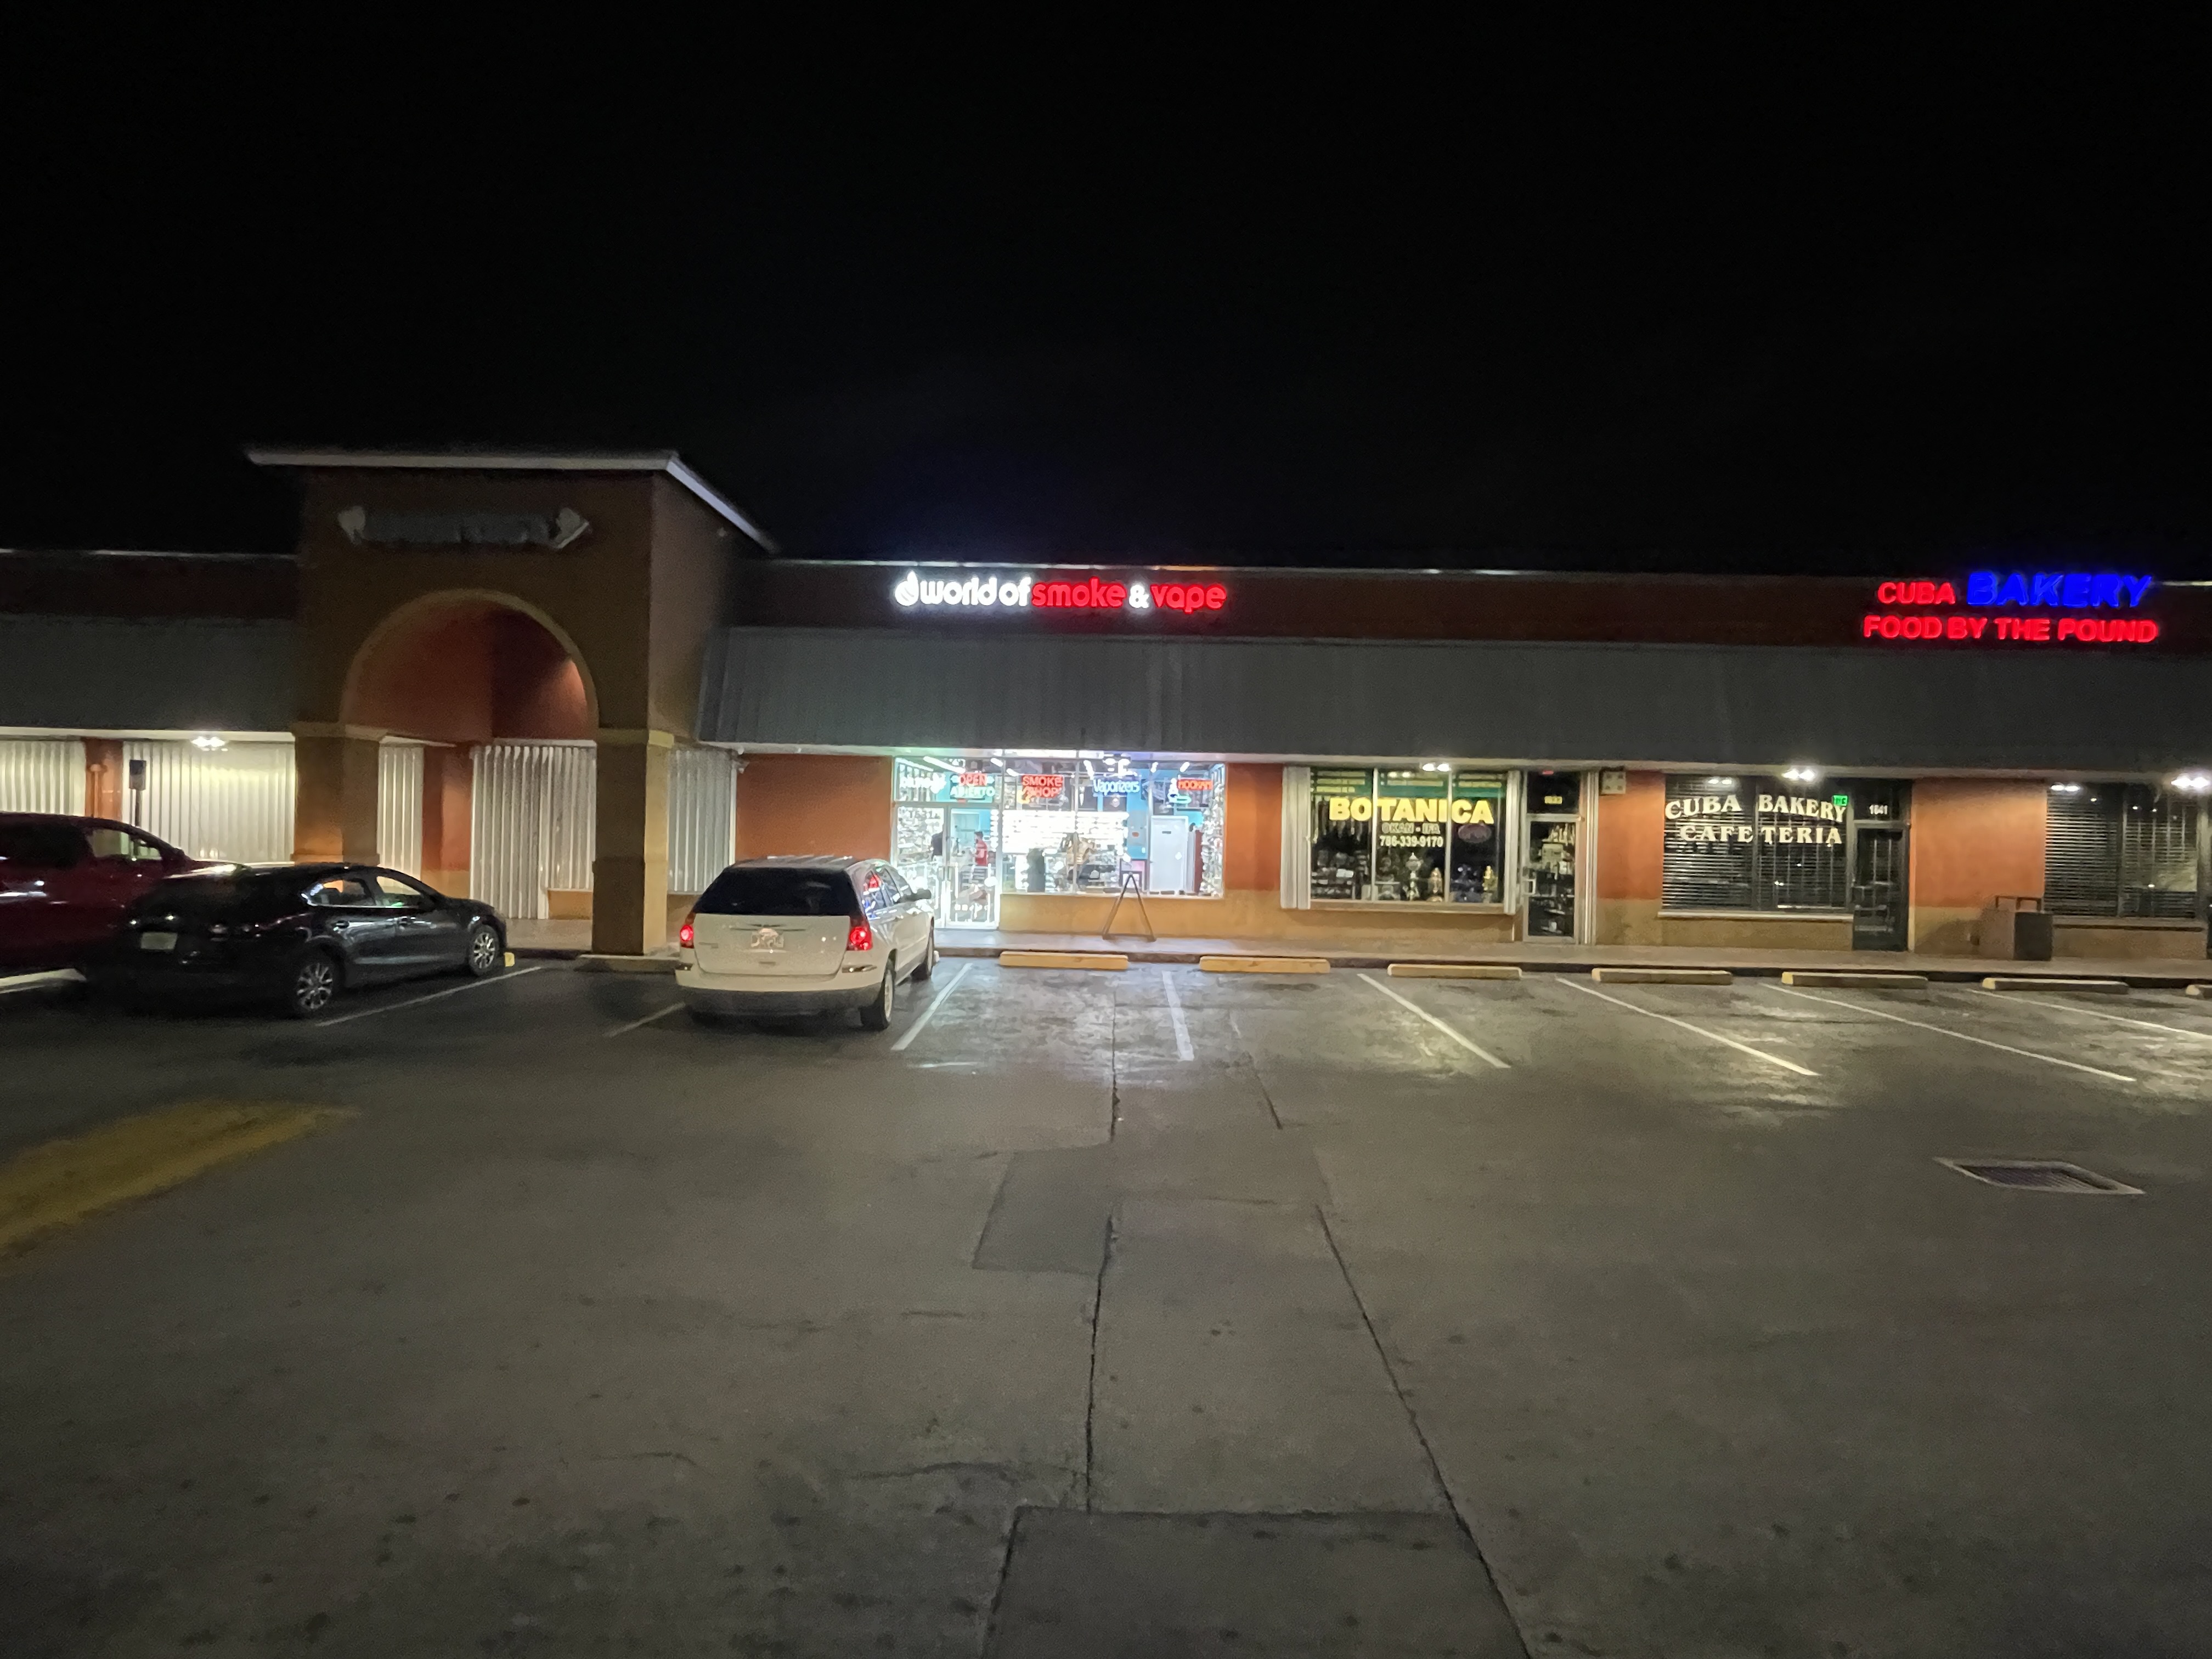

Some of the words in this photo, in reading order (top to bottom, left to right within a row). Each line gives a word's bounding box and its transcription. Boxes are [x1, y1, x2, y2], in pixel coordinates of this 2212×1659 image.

[919, 577, 997, 606] world
[998, 576, 1032, 606] of
[1032, 577, 1125, 607] smoke
[1128, 583, 1150, 608] &
[1150, 584, 1227, 614] vape
[1877, 582, 1956, 604] CUBA
[1967, 571, 2153, 608] BAKERY
[1863, 615, 1943, 639] FOOD
[1946, 616, 1988, 640] BY
[1993, 618, 2051, 641] THE
[2058, 618, 2159, 642] POUND
[960, 773, 988, 786] OPEN
[1022, 775, 1063, 787] SMOKE
[1329, 797, 1495, 825] BOTANICA
[1665, 794, 1742, 820] CUBA
[1758, 794, 1847, 823] BAKERY
[1680, 825, 1843, 844] CAFETERIA
